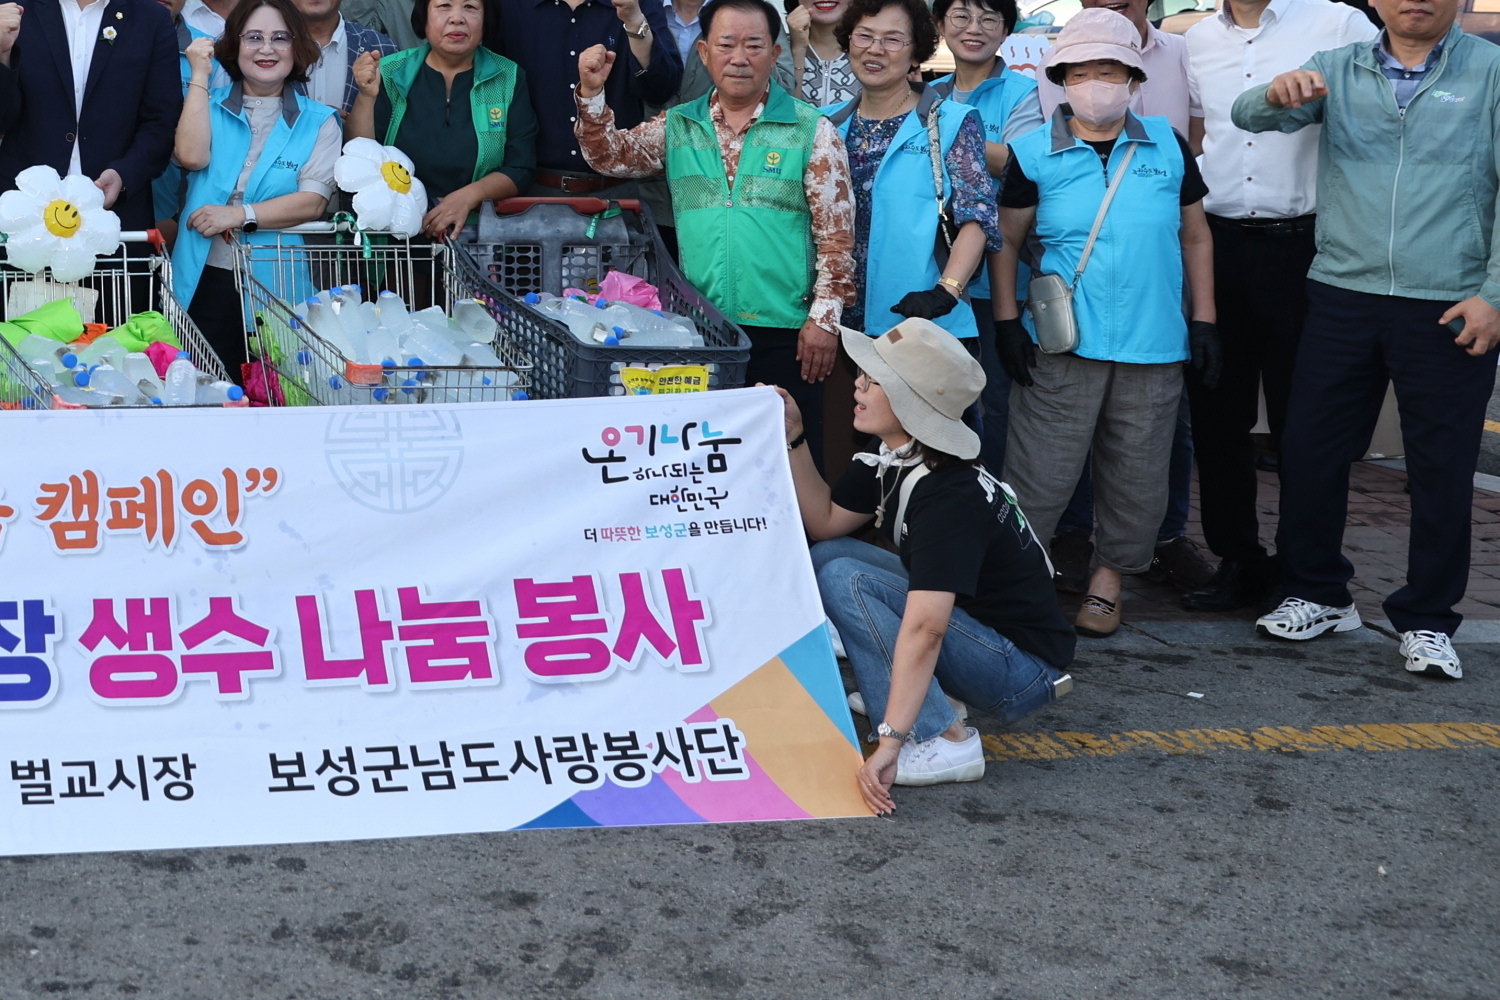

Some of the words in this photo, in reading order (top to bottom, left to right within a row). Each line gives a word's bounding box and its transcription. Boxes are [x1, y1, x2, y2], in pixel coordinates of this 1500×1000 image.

[762, 166, 782, 175] SMU
[582, 421, 742, 484] 온기나눔
[632, 462, 704, 484] 하나되는
[36, 467, 277, 550] 캠페인”
[649, 485, 729, 513] 대한민국
[584, 528, 598, 543] 더
[601, 526, 642, 542] 따뜻한
[644, 521, 702, 540] 보성군을
[704, 517, 767, 535] 만듭니다!
[78, 596, 275, 699] 생수
[295, 586, 492, 685] 나눔
[513, 567, 705, 677] 봉사
[10, 753, 197, 805] 벌교시장
[268, 724, 744, 796] 보성군남도사랑봉사단
